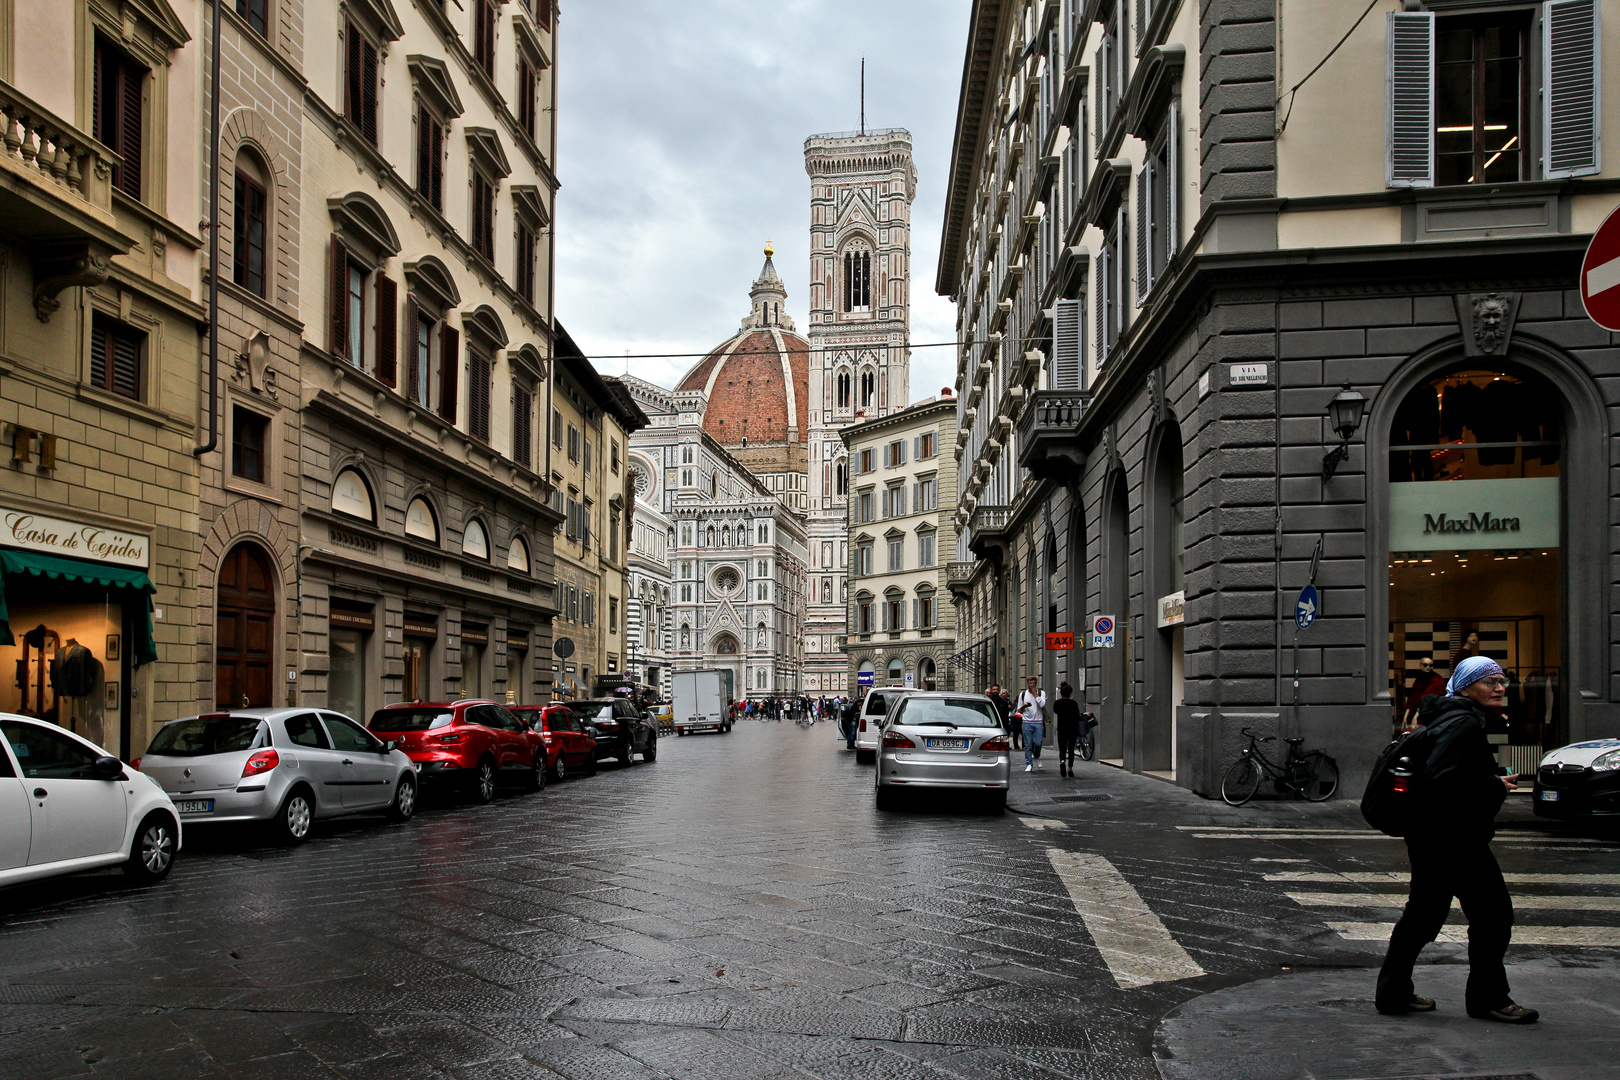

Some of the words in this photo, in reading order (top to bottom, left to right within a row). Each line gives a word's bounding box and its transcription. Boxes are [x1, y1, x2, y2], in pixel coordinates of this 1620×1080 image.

[1423, 512, 1520, 534] MaxMara
[5, 513, 58, 544] Casa
[60, 532, 78, 549] de
[81, 526, 142, 560] Tejidos
[1047, 637, 1072, 645] TAXI
[181, 801, 208, 811] 193LN
